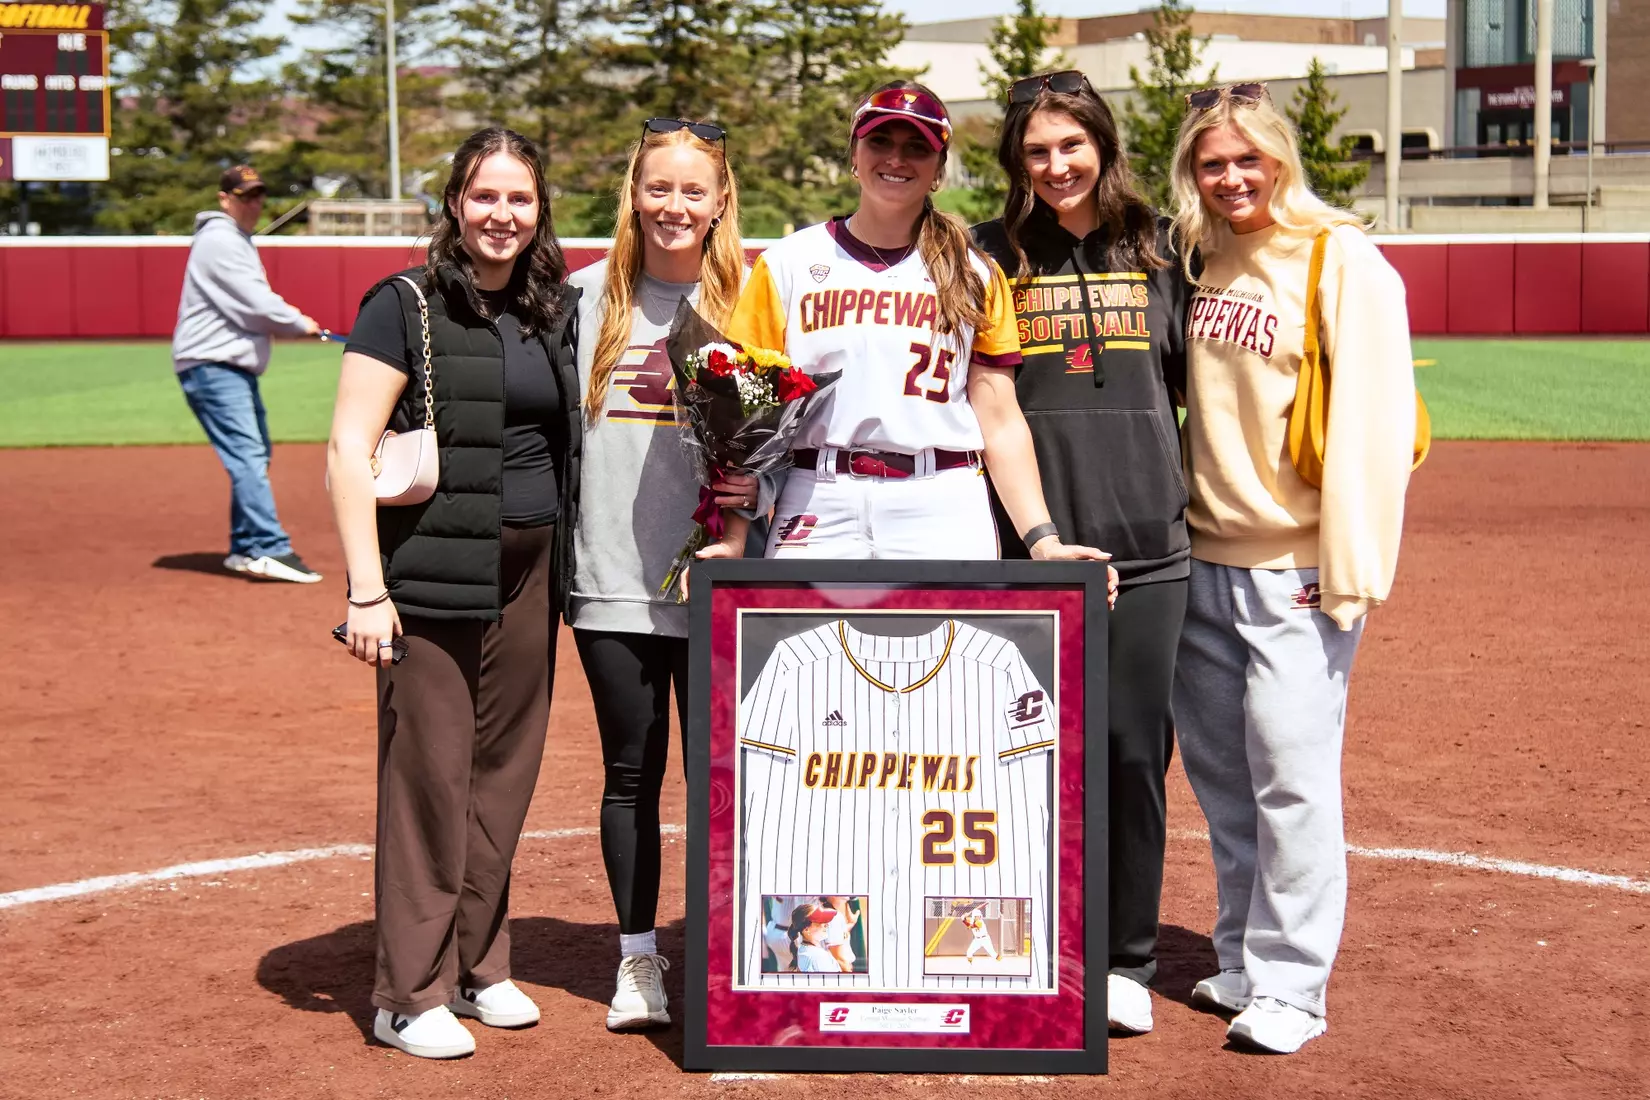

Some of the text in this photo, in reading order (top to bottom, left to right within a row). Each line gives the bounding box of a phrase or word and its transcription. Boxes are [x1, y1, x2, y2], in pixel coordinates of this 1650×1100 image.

[800, 287, 952, 335] CHIPPEWA
[1011, 283, 1149, 315] CHIPPEWAS
[903, 341, 956, 404] 25
[803, 752, 980, 792] CHIPPEWAS
[920, 809, 999, 867] 25
